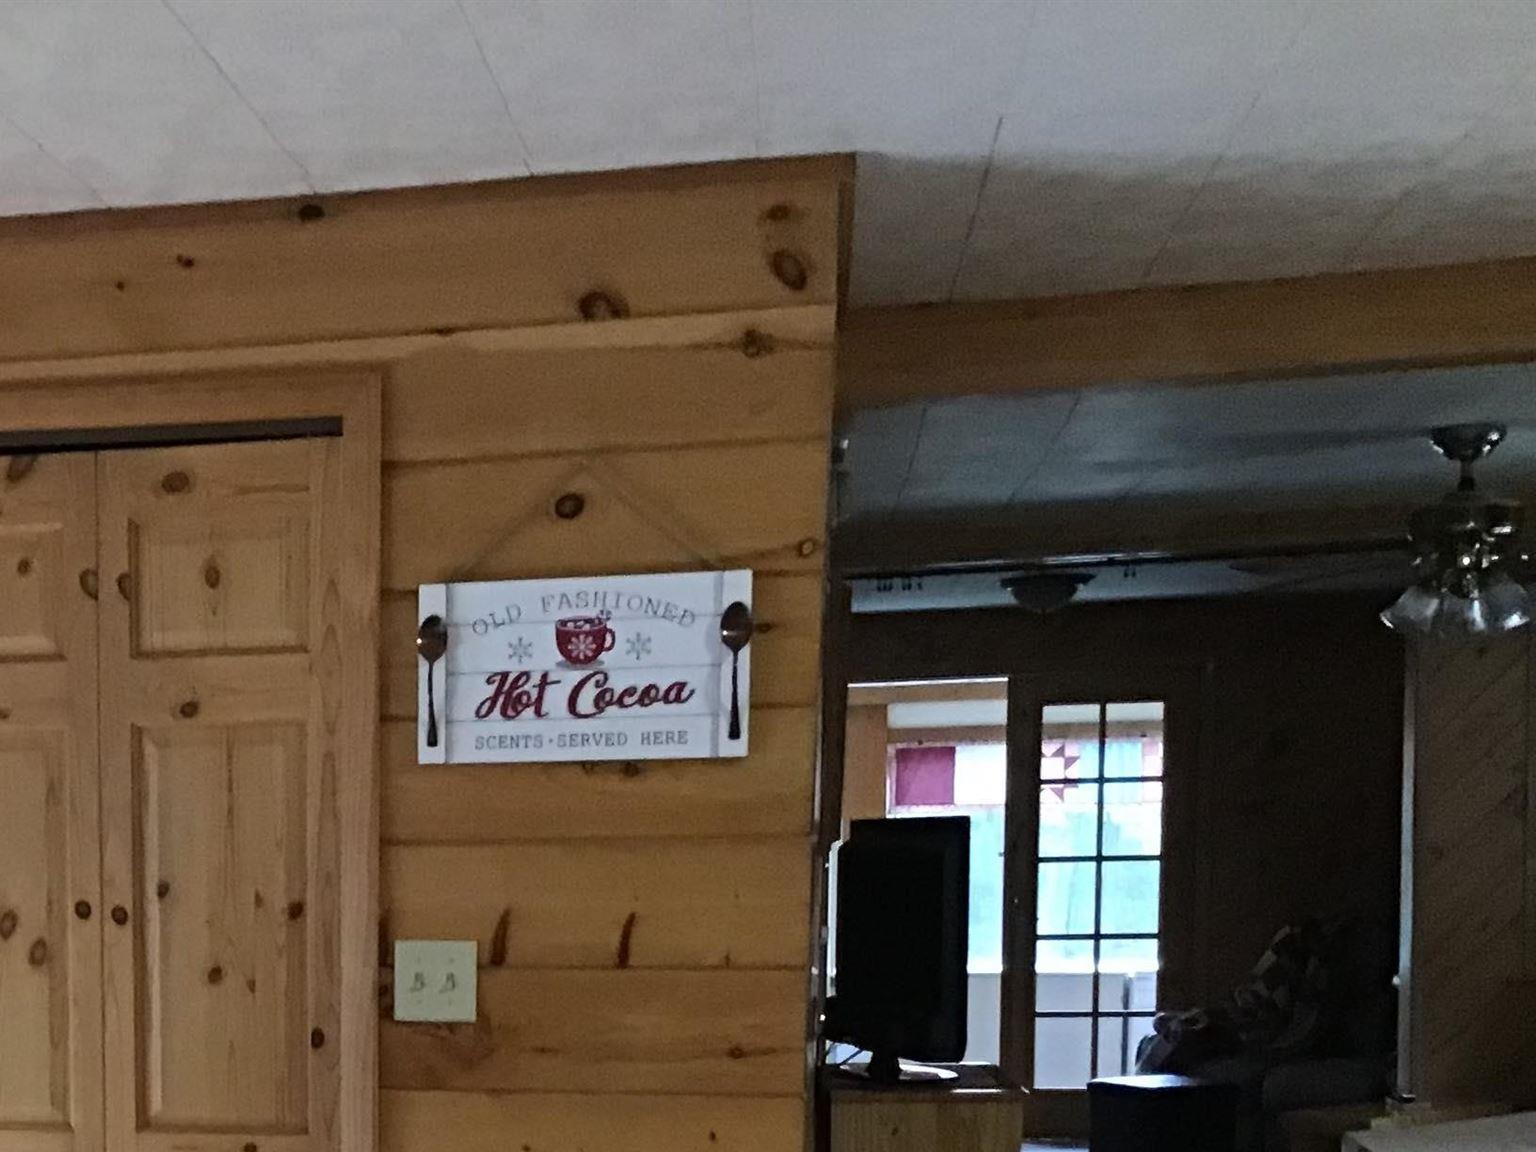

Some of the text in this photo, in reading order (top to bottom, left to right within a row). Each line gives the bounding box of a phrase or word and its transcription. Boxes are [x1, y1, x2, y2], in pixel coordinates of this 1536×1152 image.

[472, 590, 696, 636] OLD FASHIONED
[475, 671, 696, 720] Hot Cocoa
[556, 732, 629, 748] SERVED
[640, 730, 689, 746] HERE
